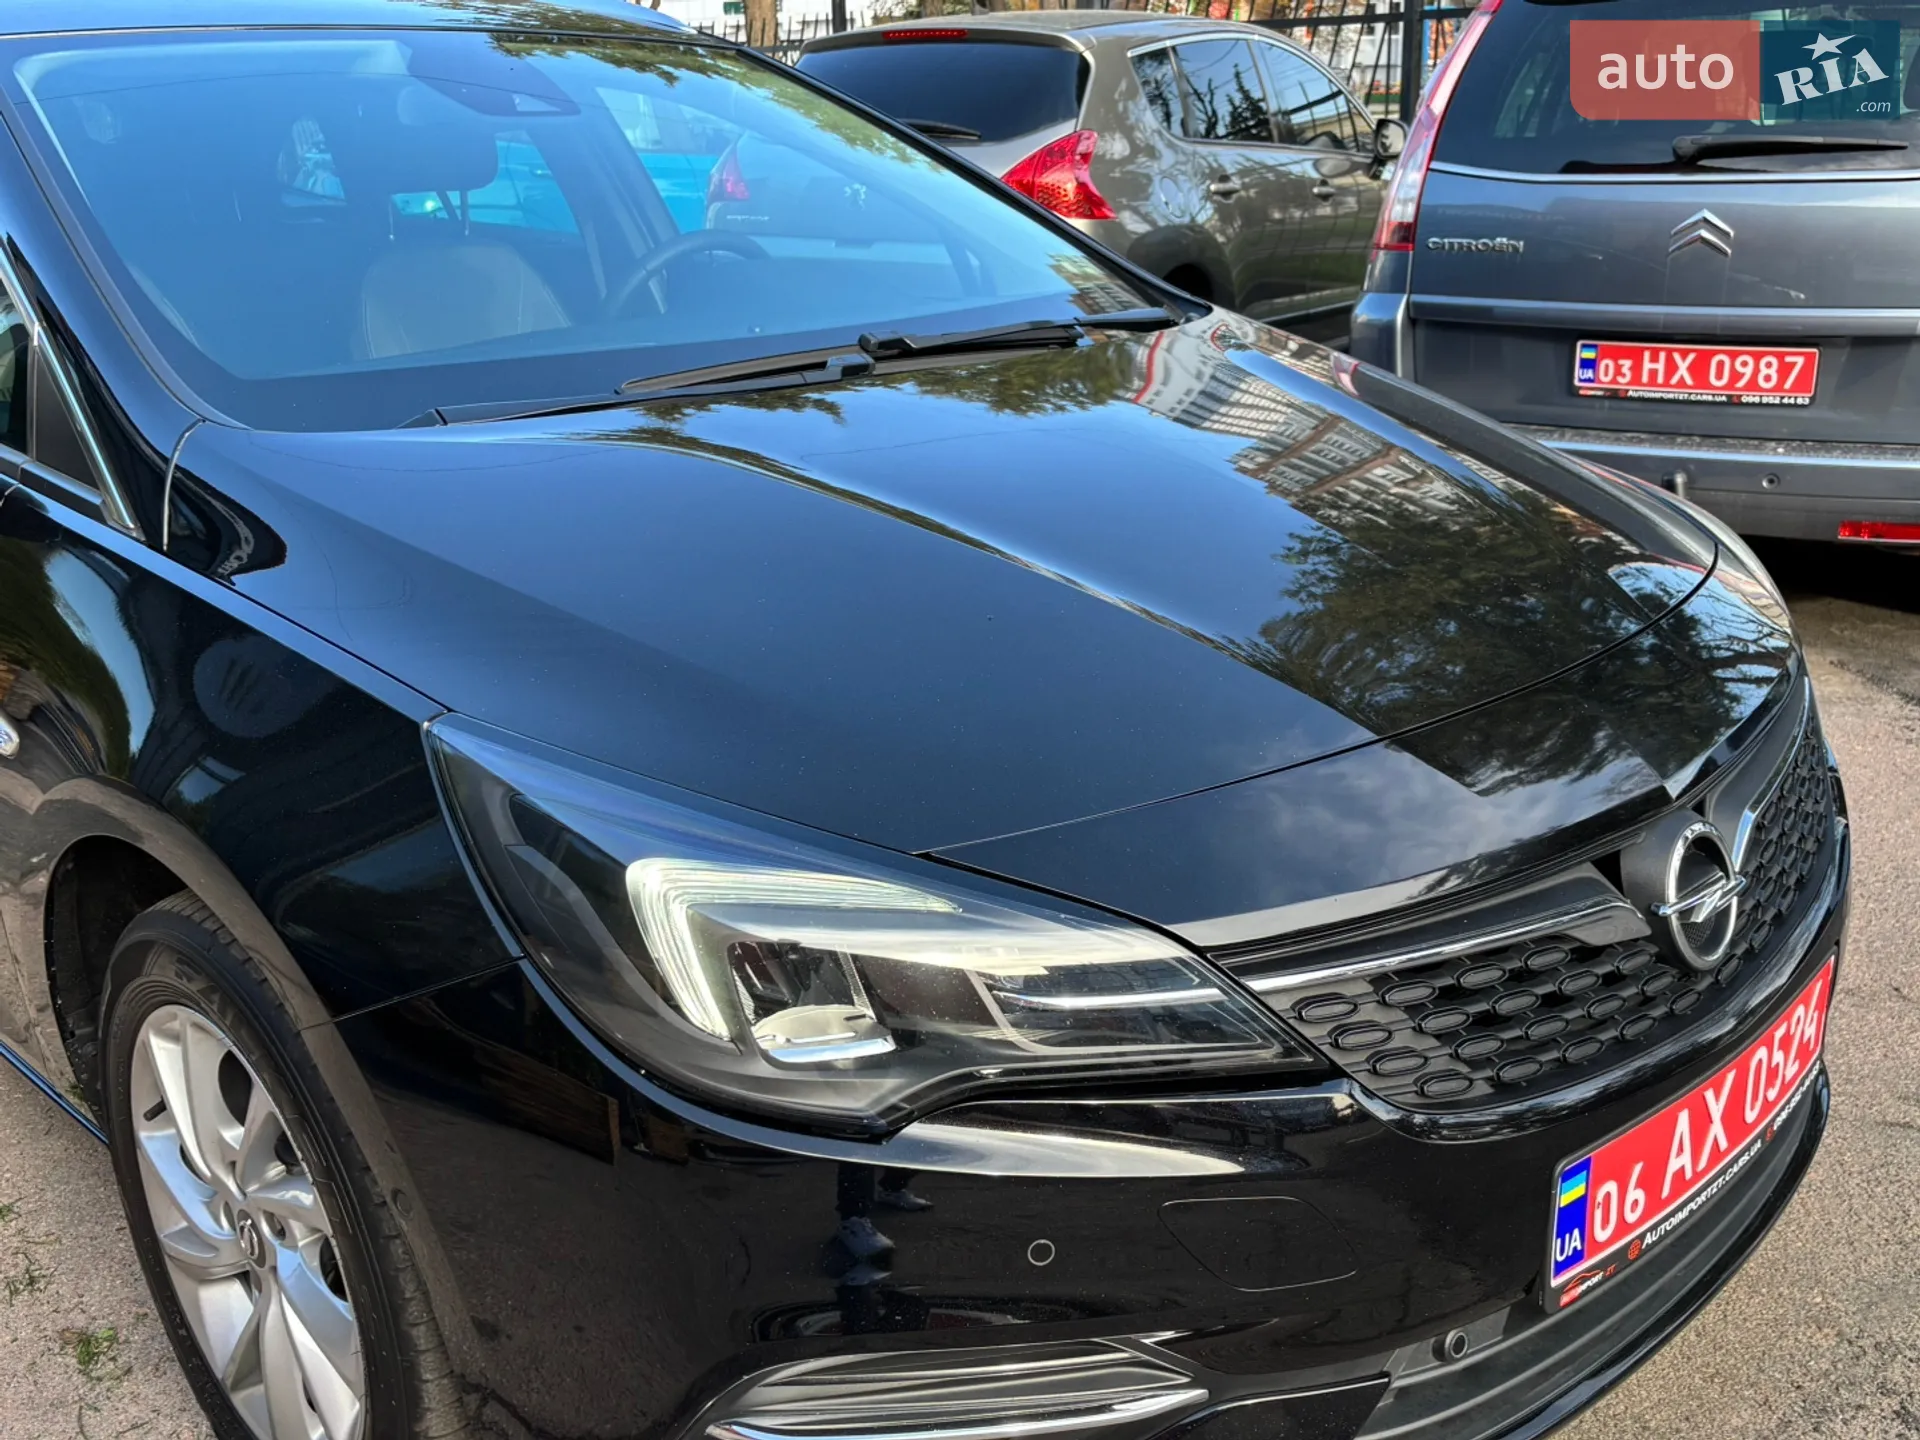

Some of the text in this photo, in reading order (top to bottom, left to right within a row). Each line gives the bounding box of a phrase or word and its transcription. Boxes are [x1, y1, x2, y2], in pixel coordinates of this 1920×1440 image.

[1427, 236, 1525, 253] CITROËN
[1579, 349, 1805, 390] UA 03 HX 0987
[1556, 1227, 1582, 1262] UA
[1593, 1161, 1645, 1243] 06
[1661, 1067, 1737, 1200] AX
[1744, 978, 1823, 1124] 0524
